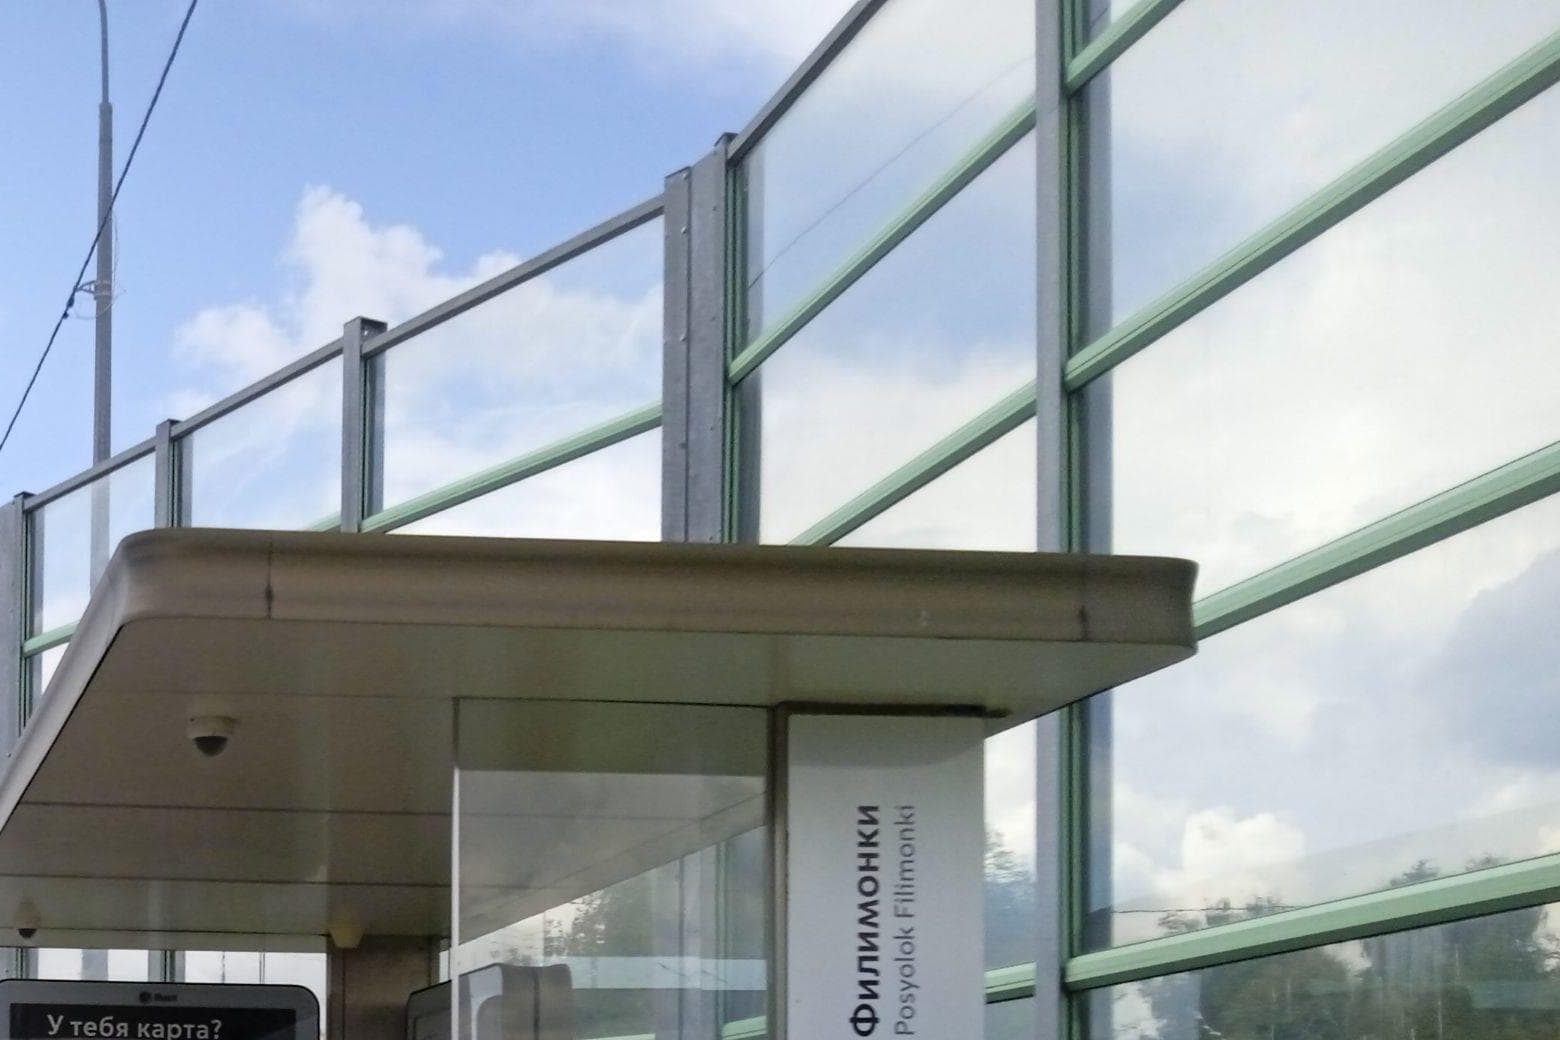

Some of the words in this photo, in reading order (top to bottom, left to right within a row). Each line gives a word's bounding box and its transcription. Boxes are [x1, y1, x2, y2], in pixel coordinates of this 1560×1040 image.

[894, 804, 916, 918] Filimonki
[850, 805, 880, 1037] Филимонки
[47, 1015, 64, 1036] У
[70, 1016, 129, 1038] тебя
[894, 926, 920, 1035] Posyolok
